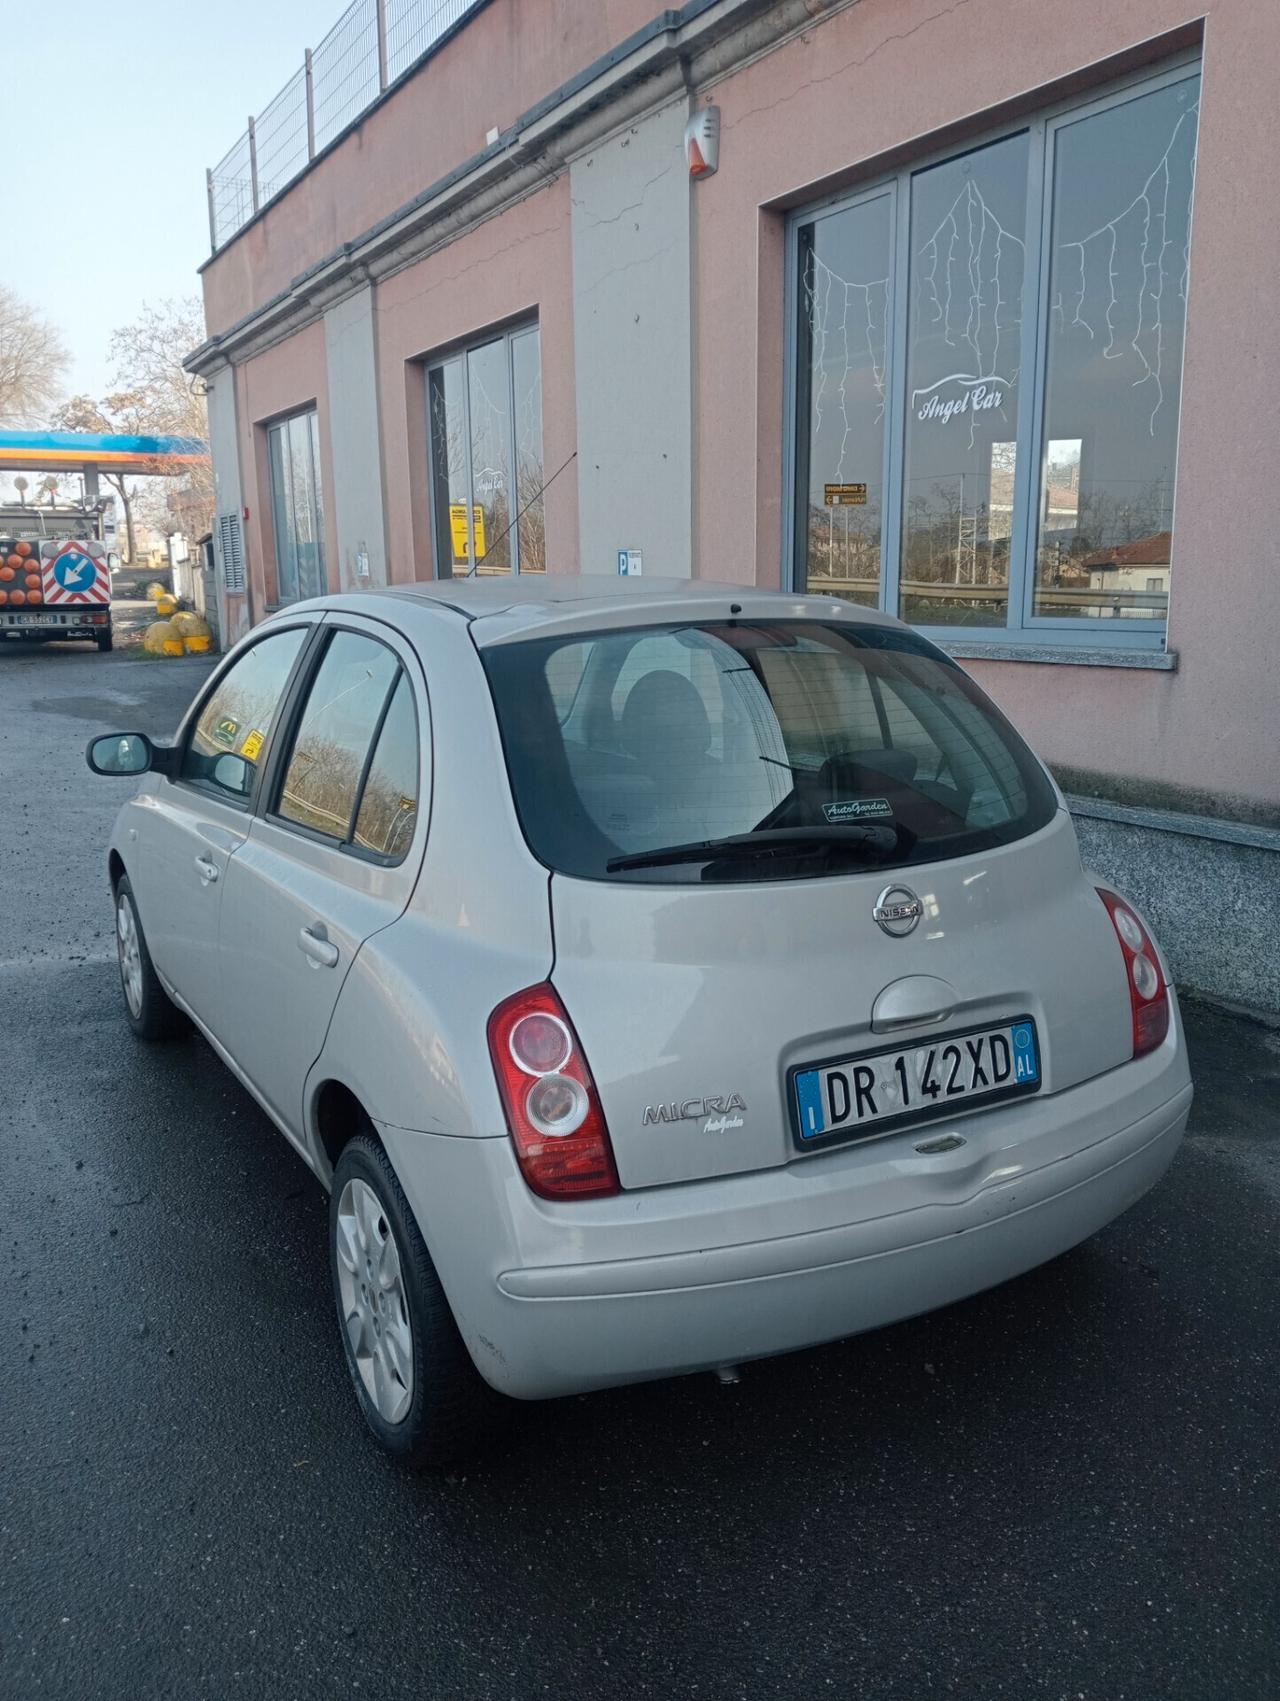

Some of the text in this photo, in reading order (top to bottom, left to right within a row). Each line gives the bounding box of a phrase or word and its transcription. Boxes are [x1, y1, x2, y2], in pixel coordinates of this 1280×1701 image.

[918, 385, 1002, 424] Angel Car
[620, 554, 627, 575] P
[826, 1033, 1012, 1125] DR 142XD
[1017, 1054, 1034, 1077] AL
[642, 1093, 748, 1126] MICRA
